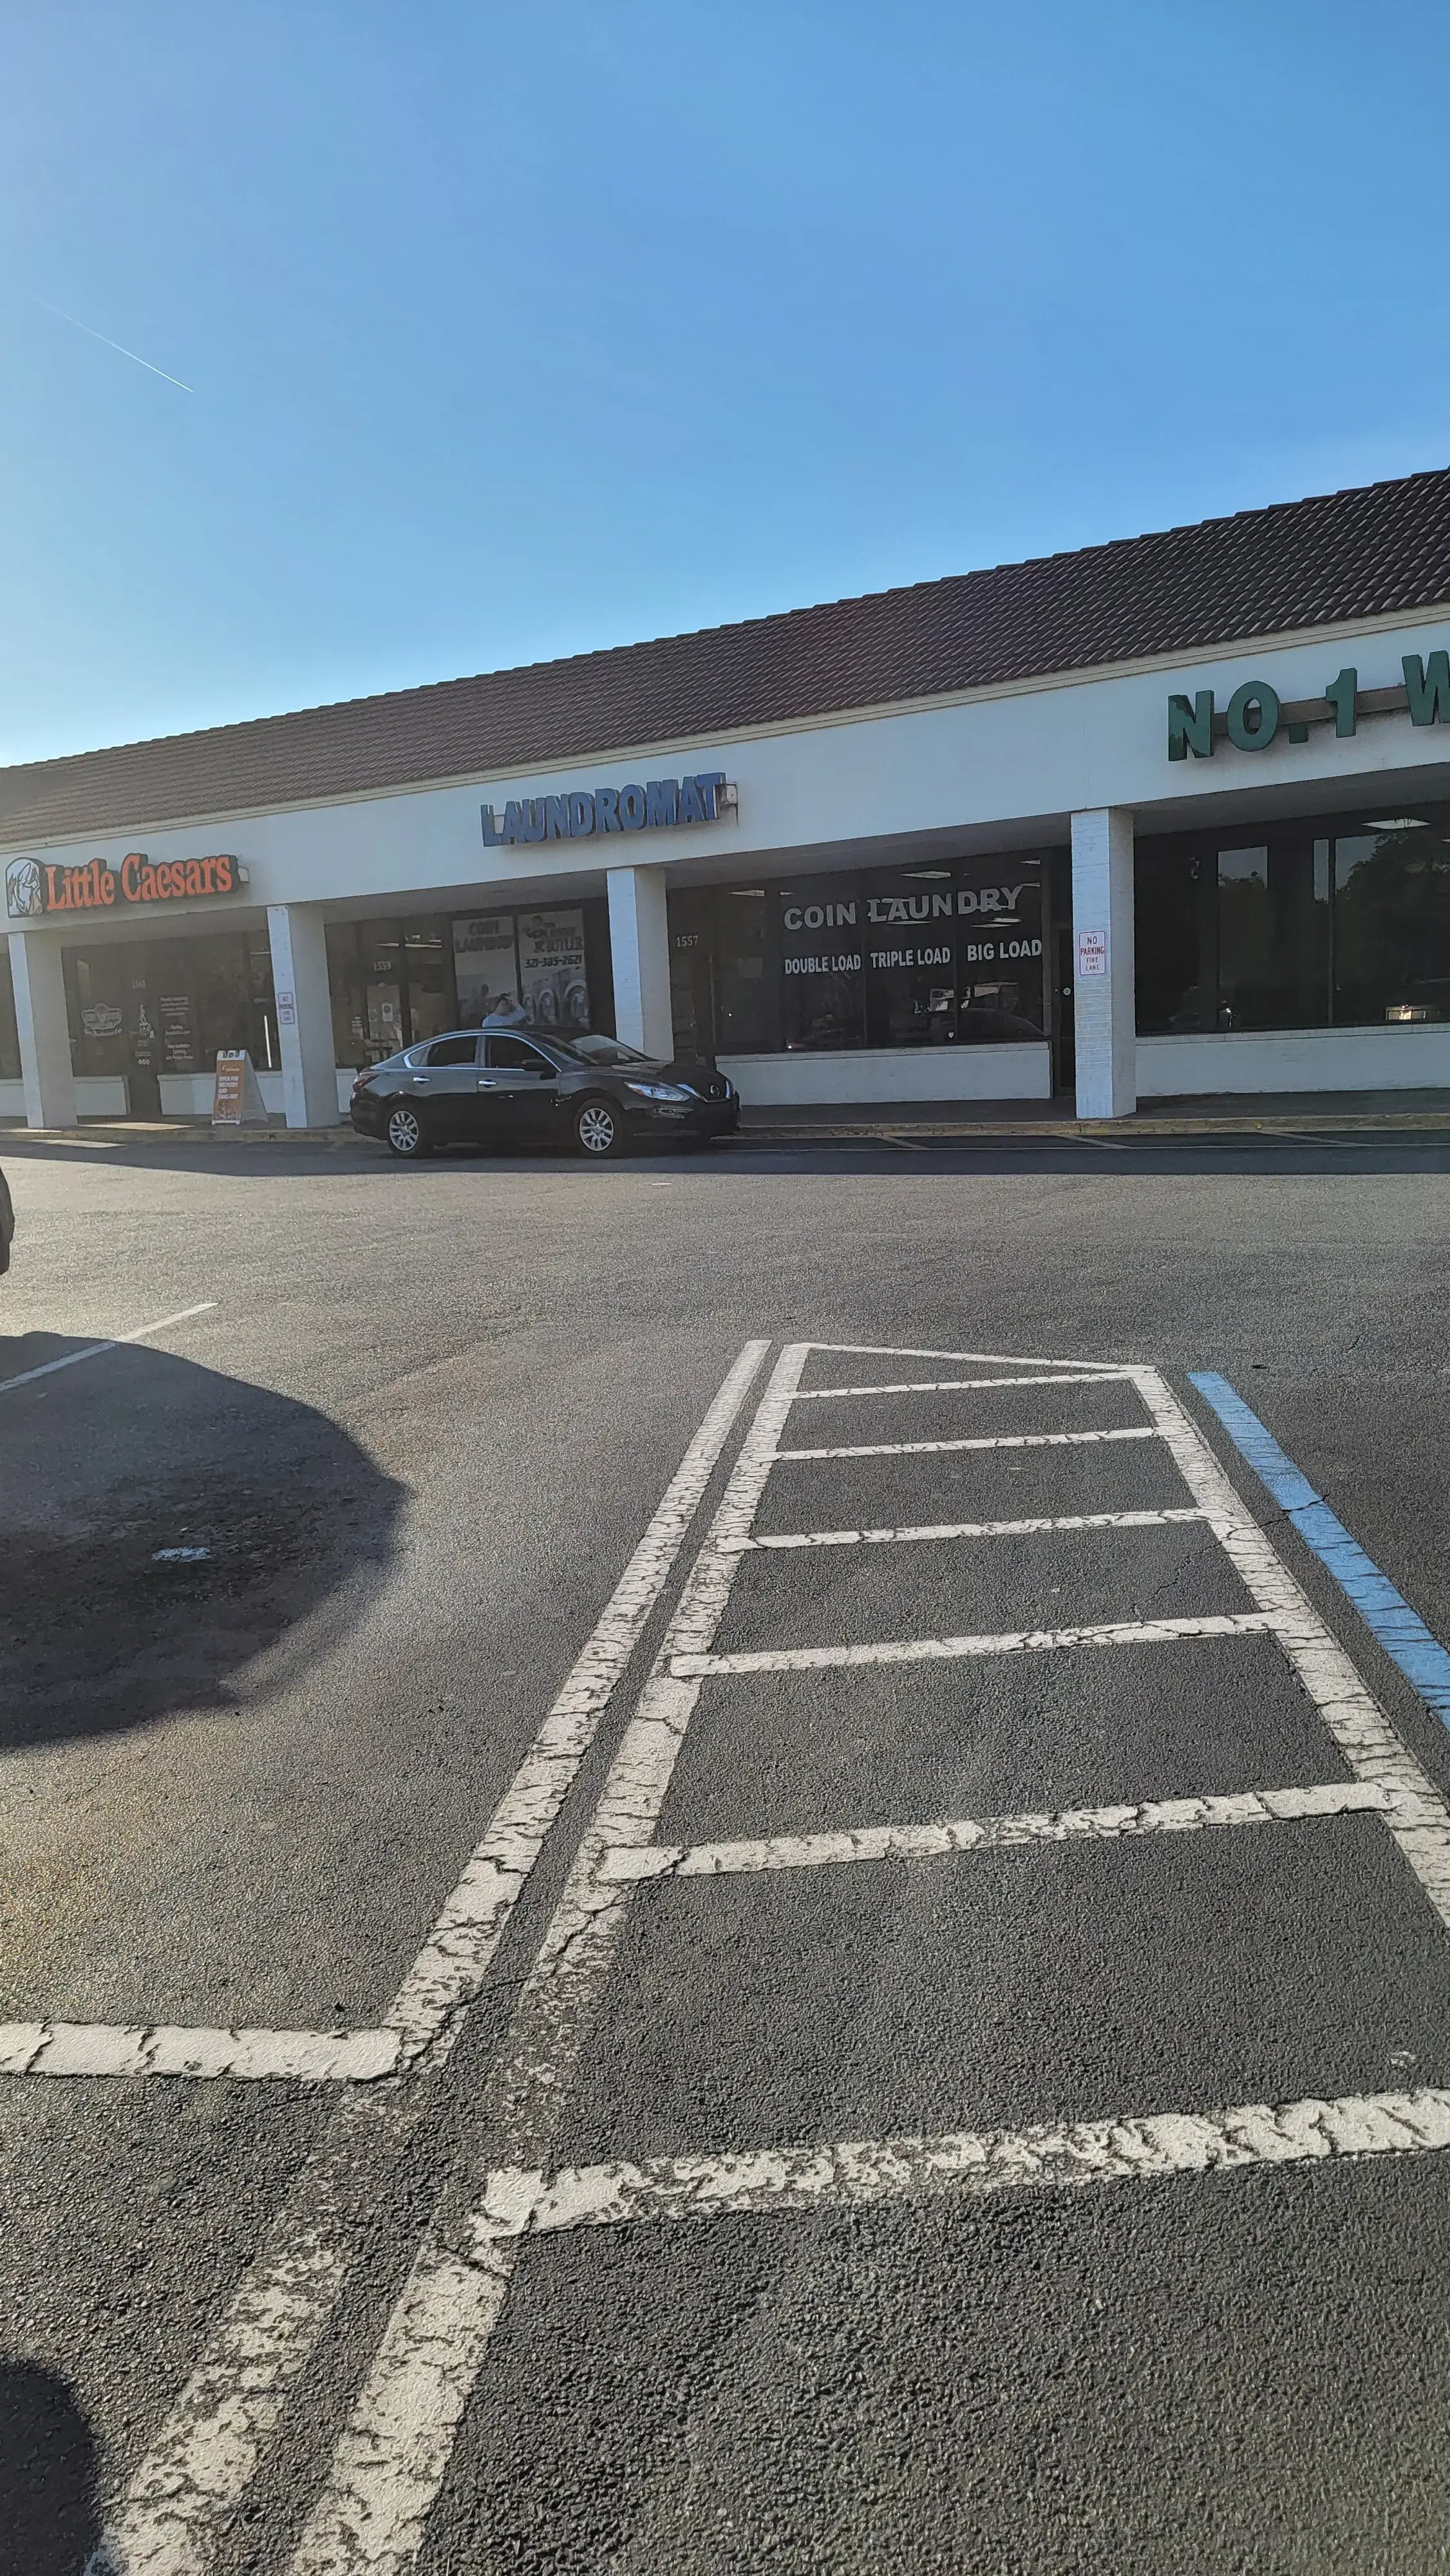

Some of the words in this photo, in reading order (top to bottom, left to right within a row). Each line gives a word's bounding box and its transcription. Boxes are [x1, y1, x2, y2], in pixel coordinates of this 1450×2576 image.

[480, 772, 726, 847] LAUNDROMAT
[46, 858, 115, 910] Little
[122, 855, 232, 902] Caesars
[784, 902, 856, 931] COIN
[869, 886, 1023, 923] LAUNDRY
[676, 935, 699, 947] 1557
[967, 943, 995, 961] BIG
[999, 939, 1042, 959] LOAD
[1080, 945, 1104, 956] PARKING
[1087, 936, 1098, 945] NO
[373, 961, 391, 971] 1559
[784, 956, 830, 974] DOUBLE
[832, 954, 862, 972] LOAD
[870, 949, 914, 969] TRIPLE
[917, 947, 950, 965] LOAD
